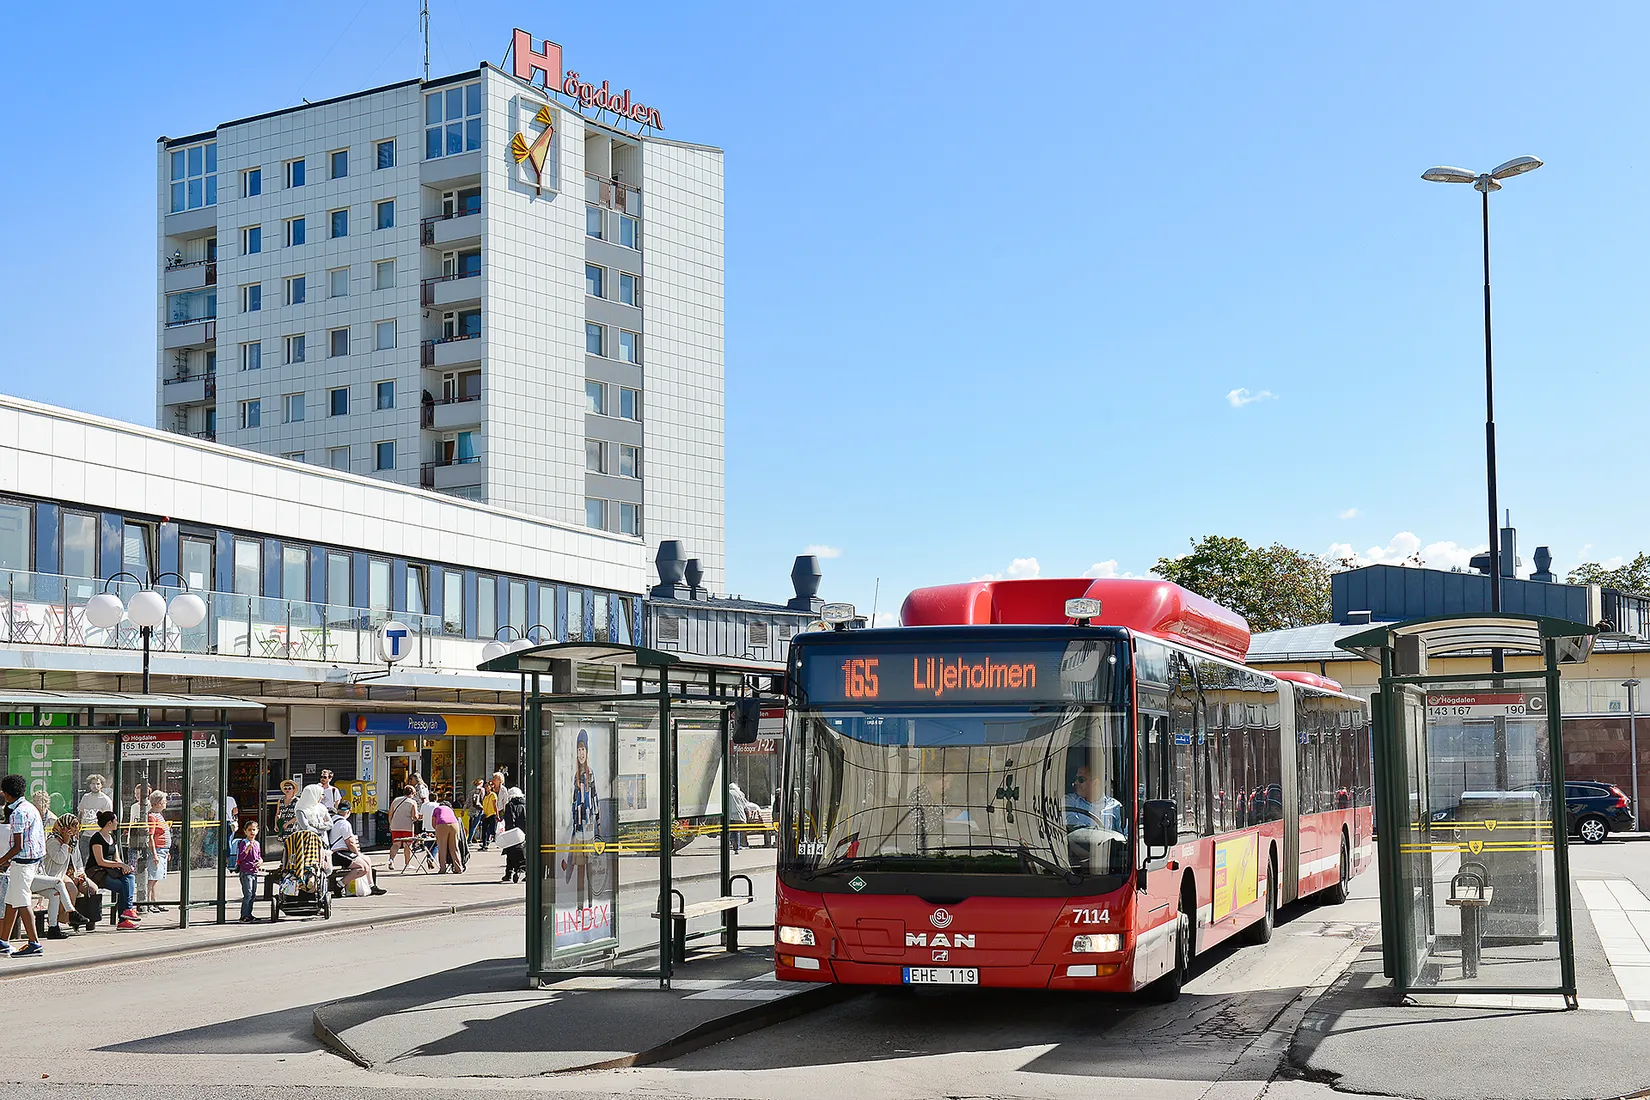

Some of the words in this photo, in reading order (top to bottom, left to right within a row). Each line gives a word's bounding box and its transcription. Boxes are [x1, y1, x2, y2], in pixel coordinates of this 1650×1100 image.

[513, 28, 665, 130] Högdalen
[386, 629, 407, 656] T
[841, 658, 879, 698] 165
[912, 656, 1037, 697] Liljeholmen
[1440, 696, 1476, 705] Högdalen
[1529, 696, 1543, 711] C
[1428, 706, 1448, 716] 143
[1452, 706, 1471, 716] 167
[1505, 705, 1525, 715] 190
[407, 717, 439, 732] Pressbyrån
[122, 742, 135, 750] 165
[137, 742, 150, 750] 167
[151, 741, 166, 749] 906
[192, 740, 205, 748] 195
[131, 734, 157, 742] Högdalen
[208, 734, 218, 745] A
[555, 904, 609, 937] LINDEX
[936, 911, 947, 920] SL
[1072, 908, 1110, 924] 7114
[905, 932, 976, 948] MAN
[911, 969, 937, 983] EHE
[949, 969, 976, 983] 119
